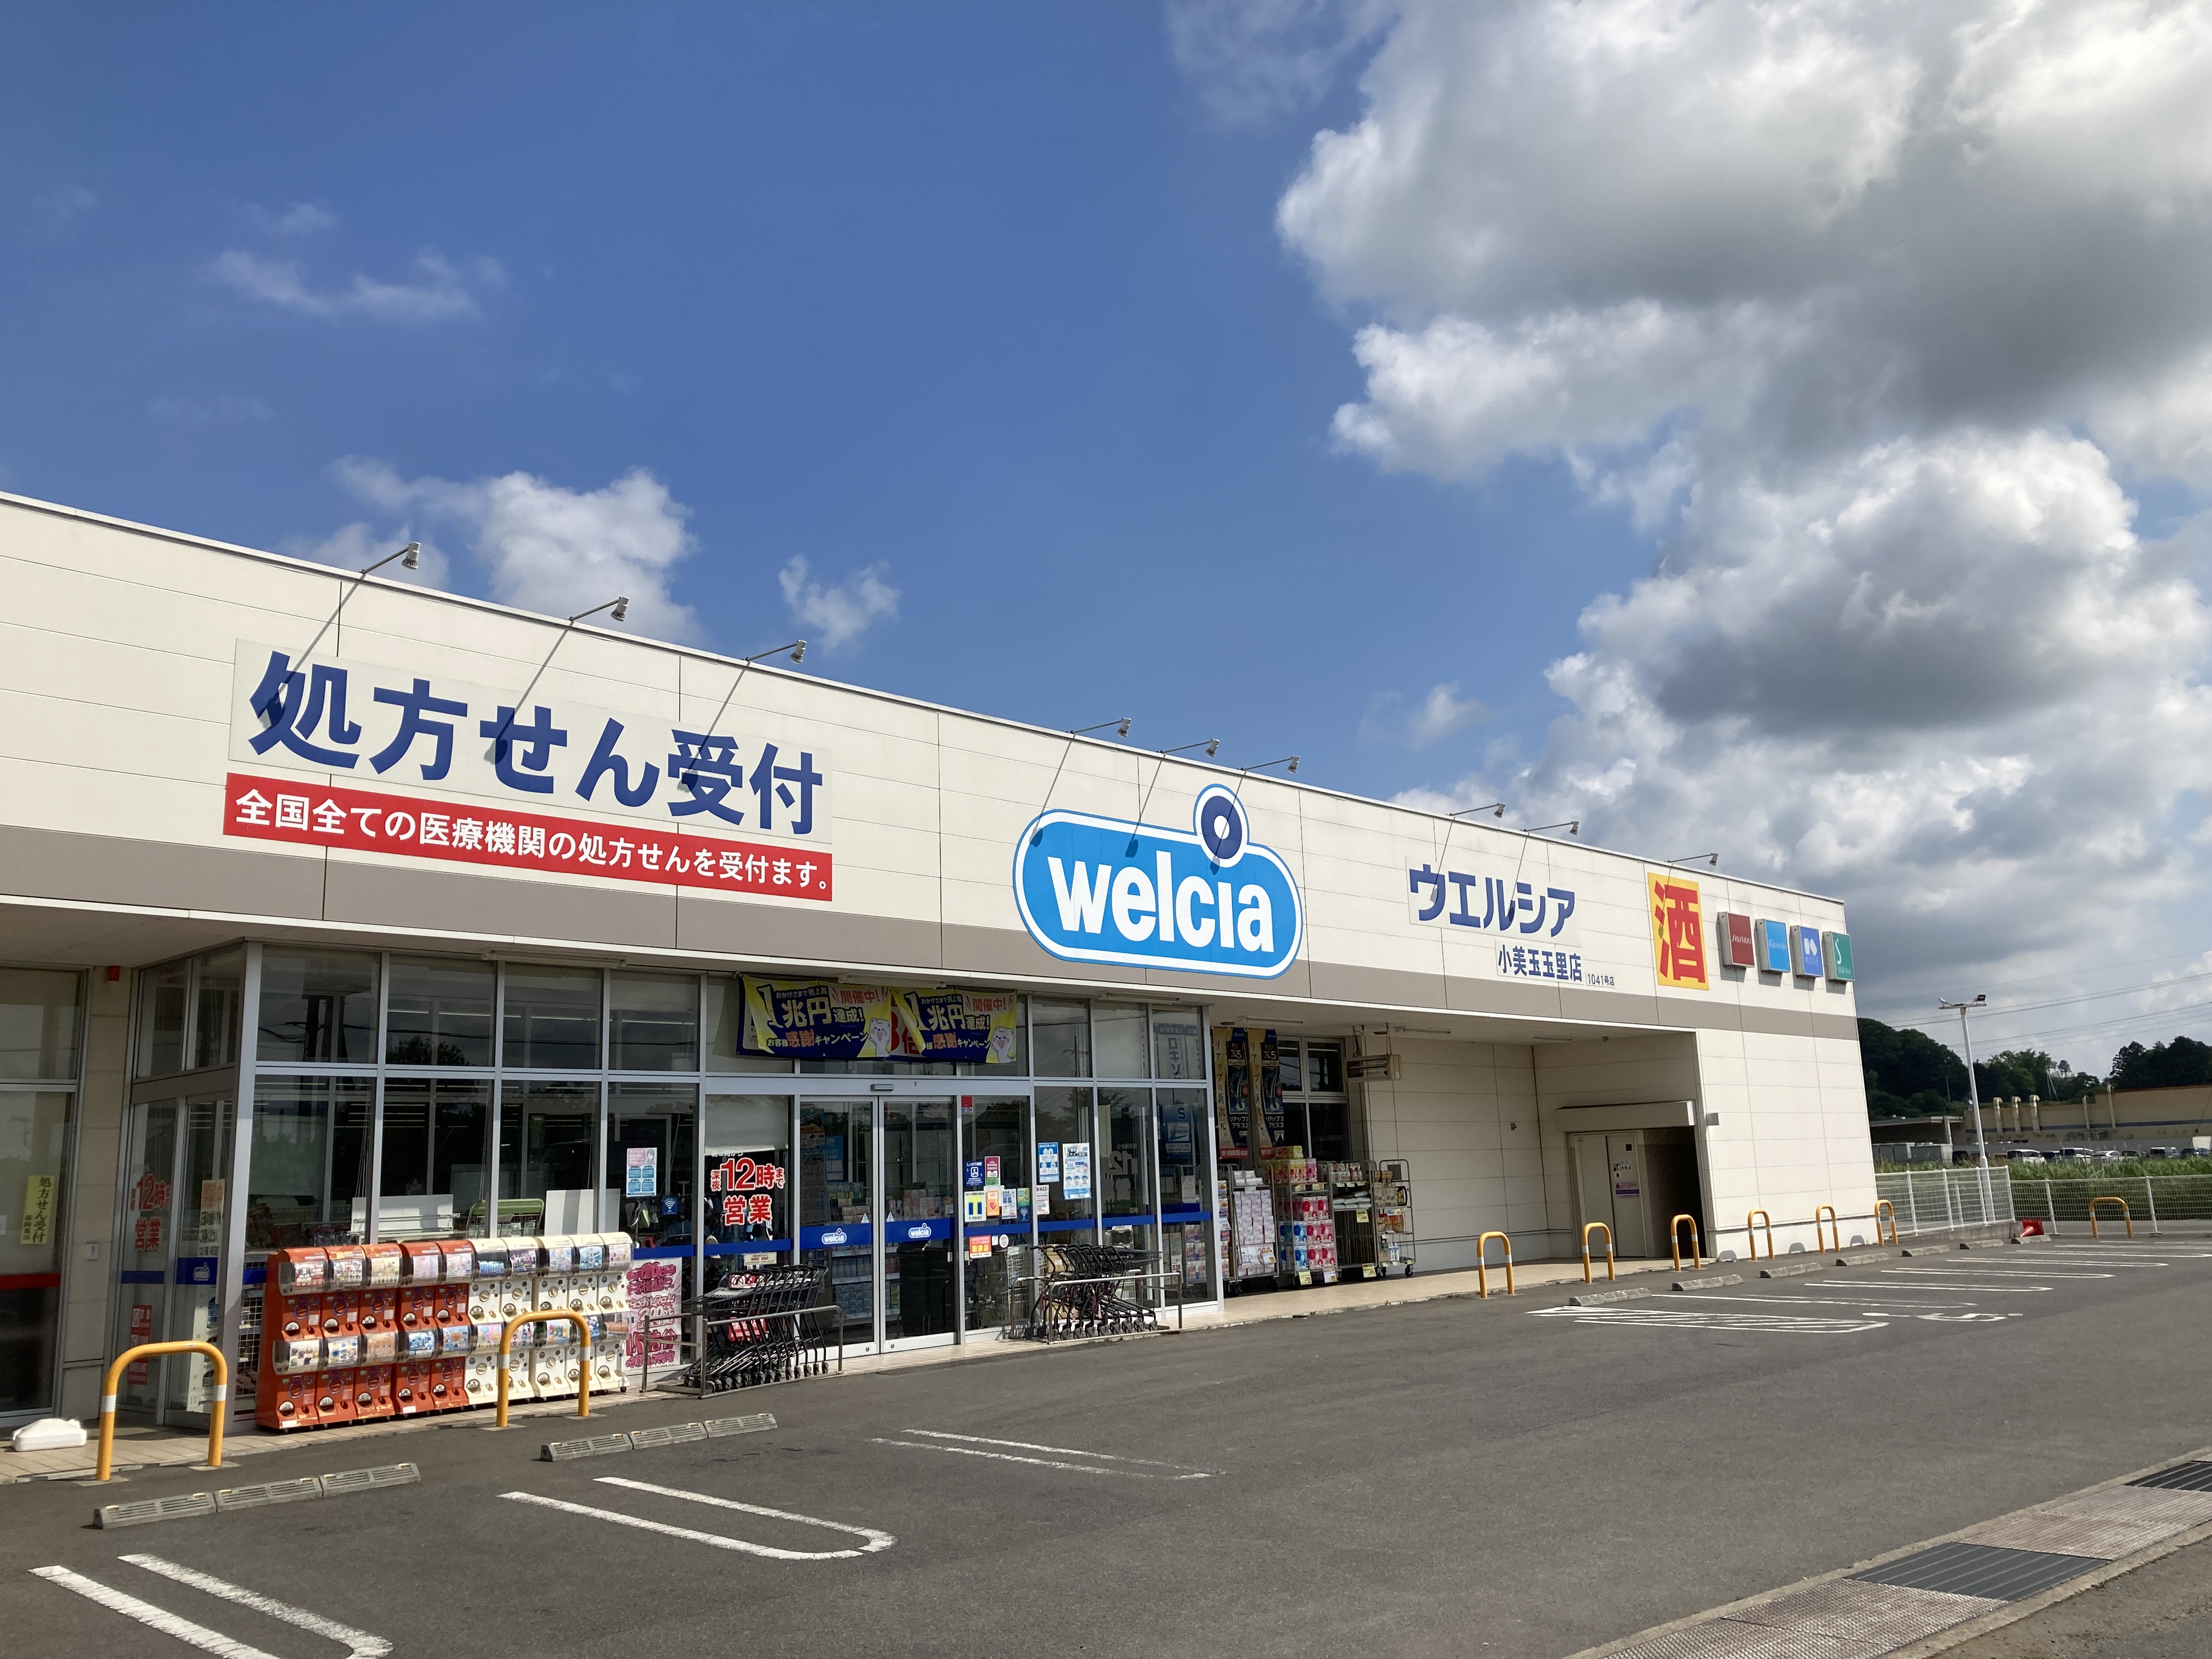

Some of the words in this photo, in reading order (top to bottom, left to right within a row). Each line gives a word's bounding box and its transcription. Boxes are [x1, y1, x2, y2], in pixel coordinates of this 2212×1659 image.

[247, 651, 823, 834] 処方せん受付
[235, 788, 827, 890] 全国全ての医療機関の処方せんを受付ます。
[1047, 795, 1274, 953] welcia
[1409, 864, 1575, 938] ウエルシア
[1655, 881, 1706, 983] 酒
[1732, 934, 1752, 944] SHISEIDO
[1498, 944, 1582, 983] 小美玉玉里店
[1587, 973, 1615, 987] 1041号店
[1231, 1049, 1242, 1059] X5
[1263, 1051, 1276, 1060] X5
[32, 1177, 53, 1243] 処方せん受付
[724, 1194, 772, 1226] 営業
[135, 1216, 161, 1250] 営業
[823, 1229, 845, 1243] welcia
[910, 1224, 930, 1237] welcia
